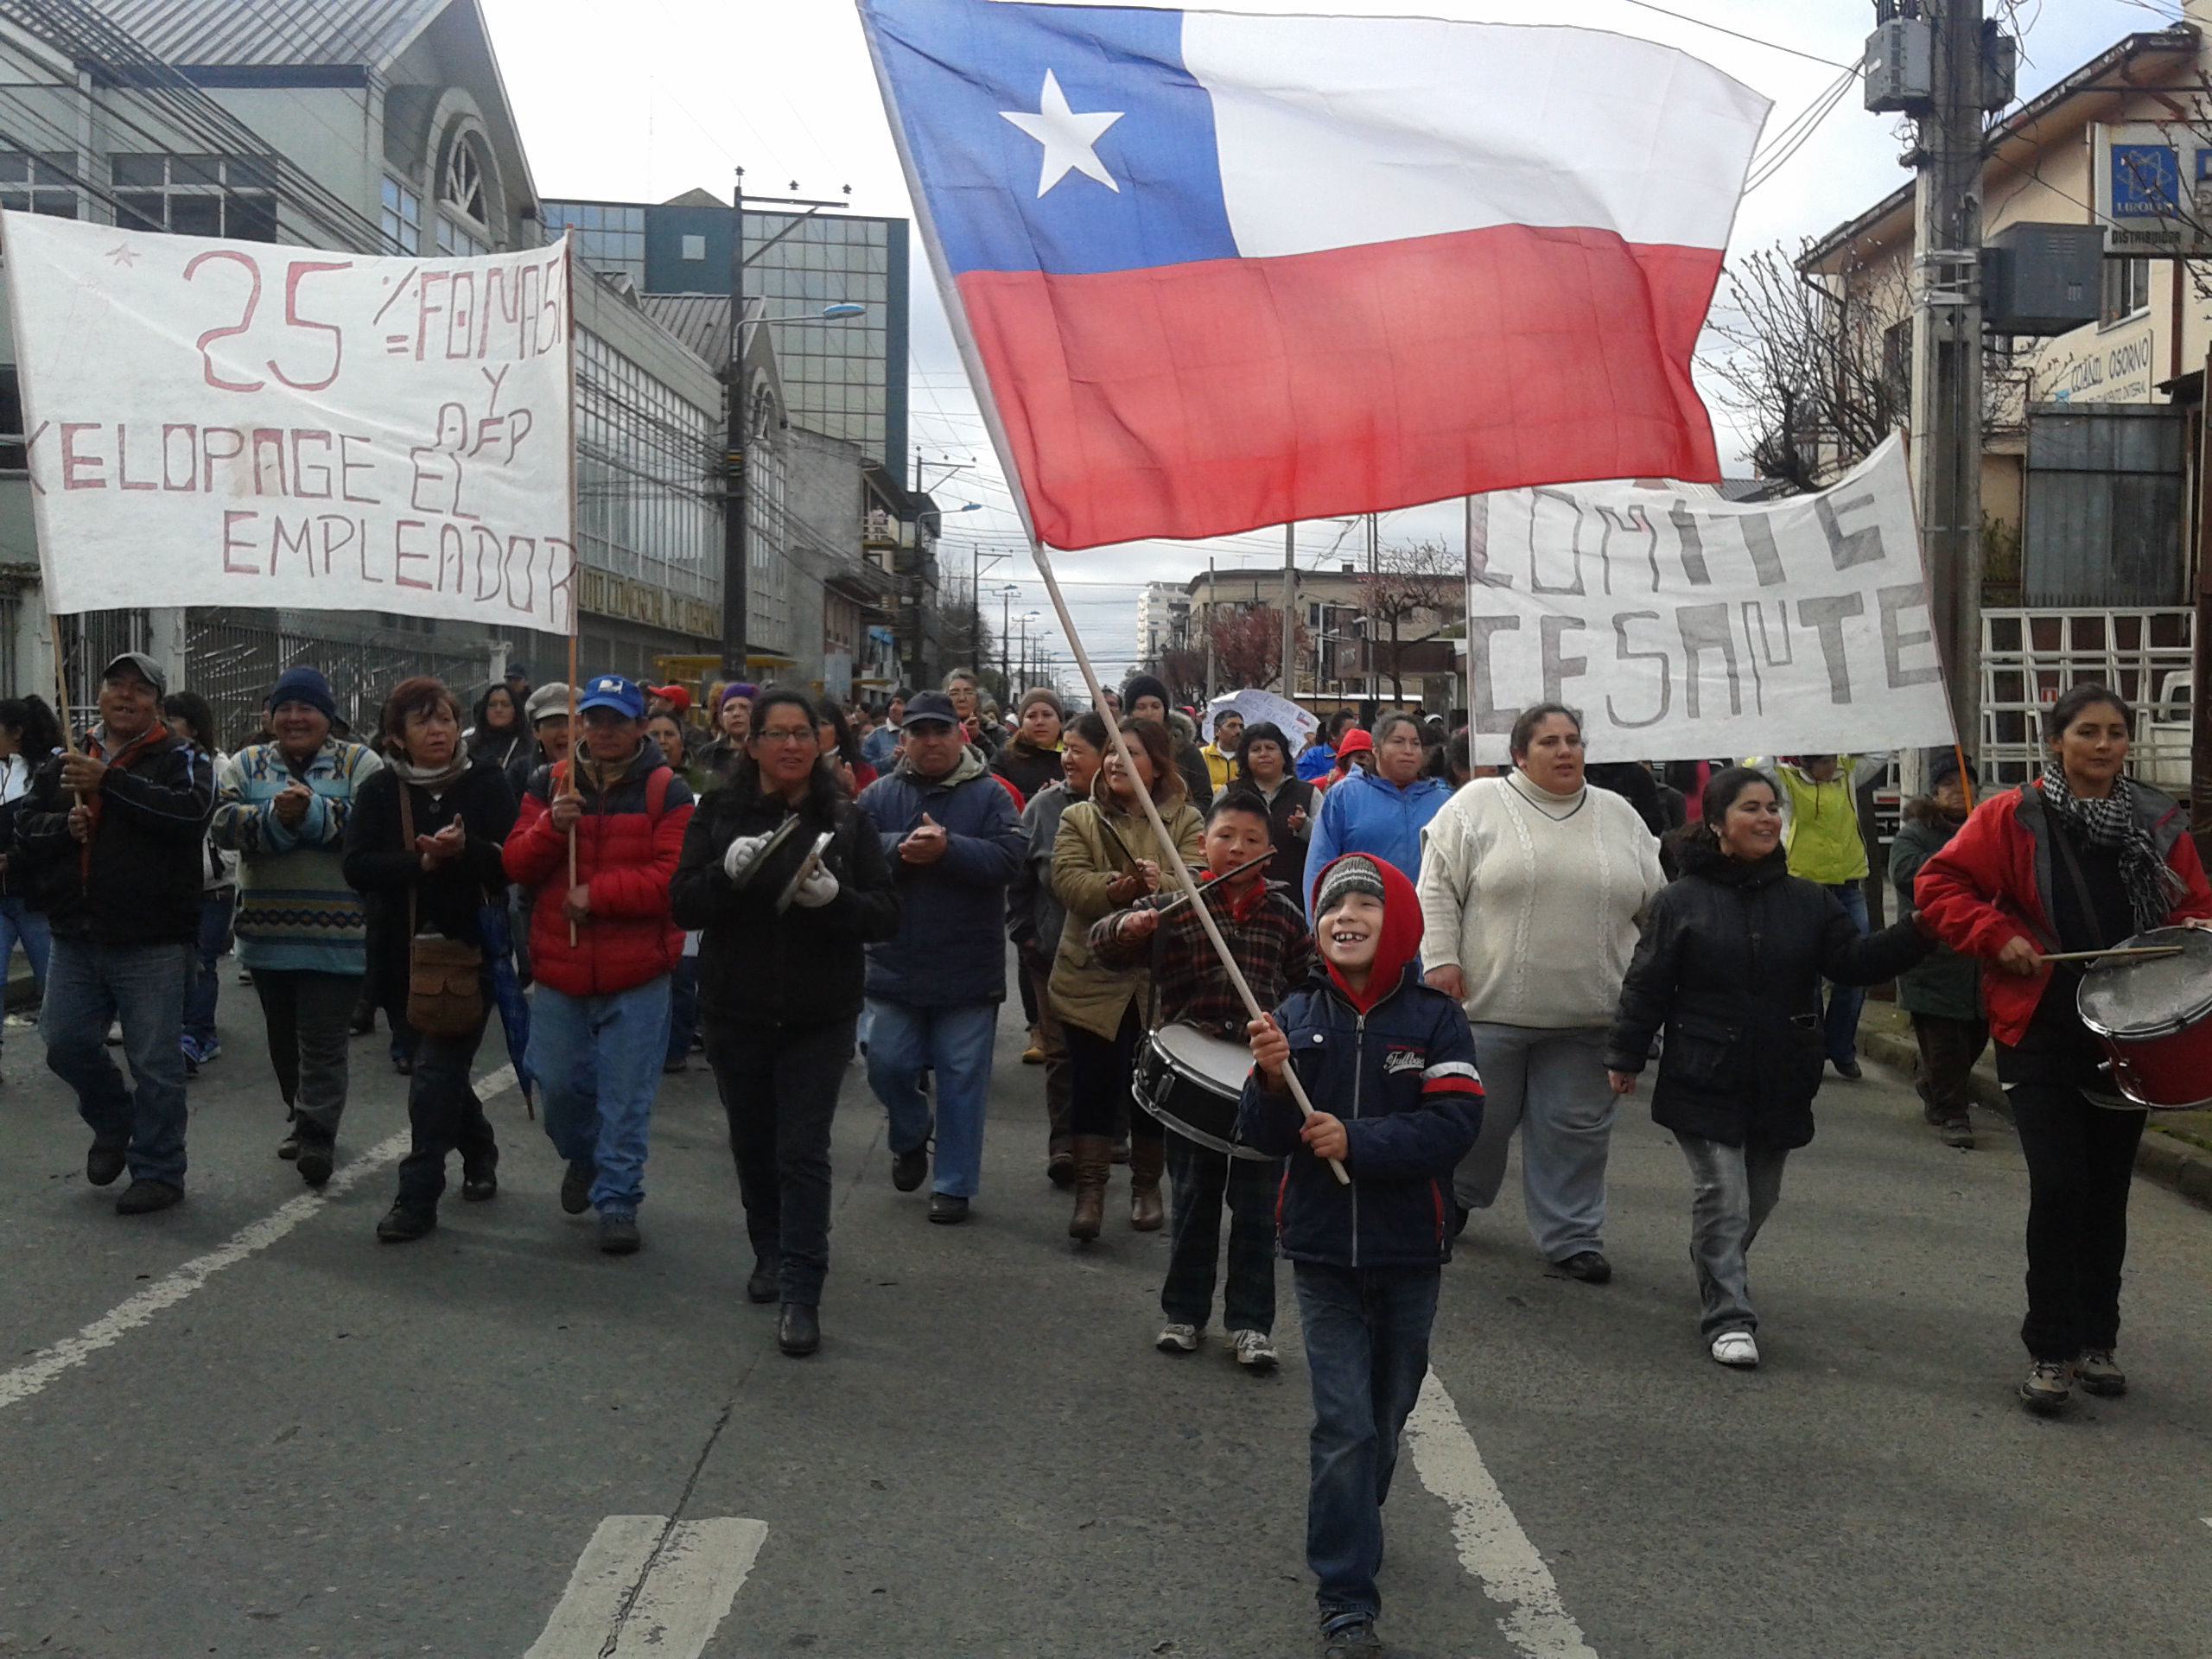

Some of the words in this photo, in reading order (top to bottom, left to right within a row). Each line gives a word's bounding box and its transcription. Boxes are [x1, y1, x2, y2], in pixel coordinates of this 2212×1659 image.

[480, 363, 510, 418] Y
[2109, 336, 2149, 381] OSORNO
[410, 446, 480, 522] EL
[223, 510, 577, 632] EMPLEADOR
[1470, 581, 1946, 735] CESANTE
